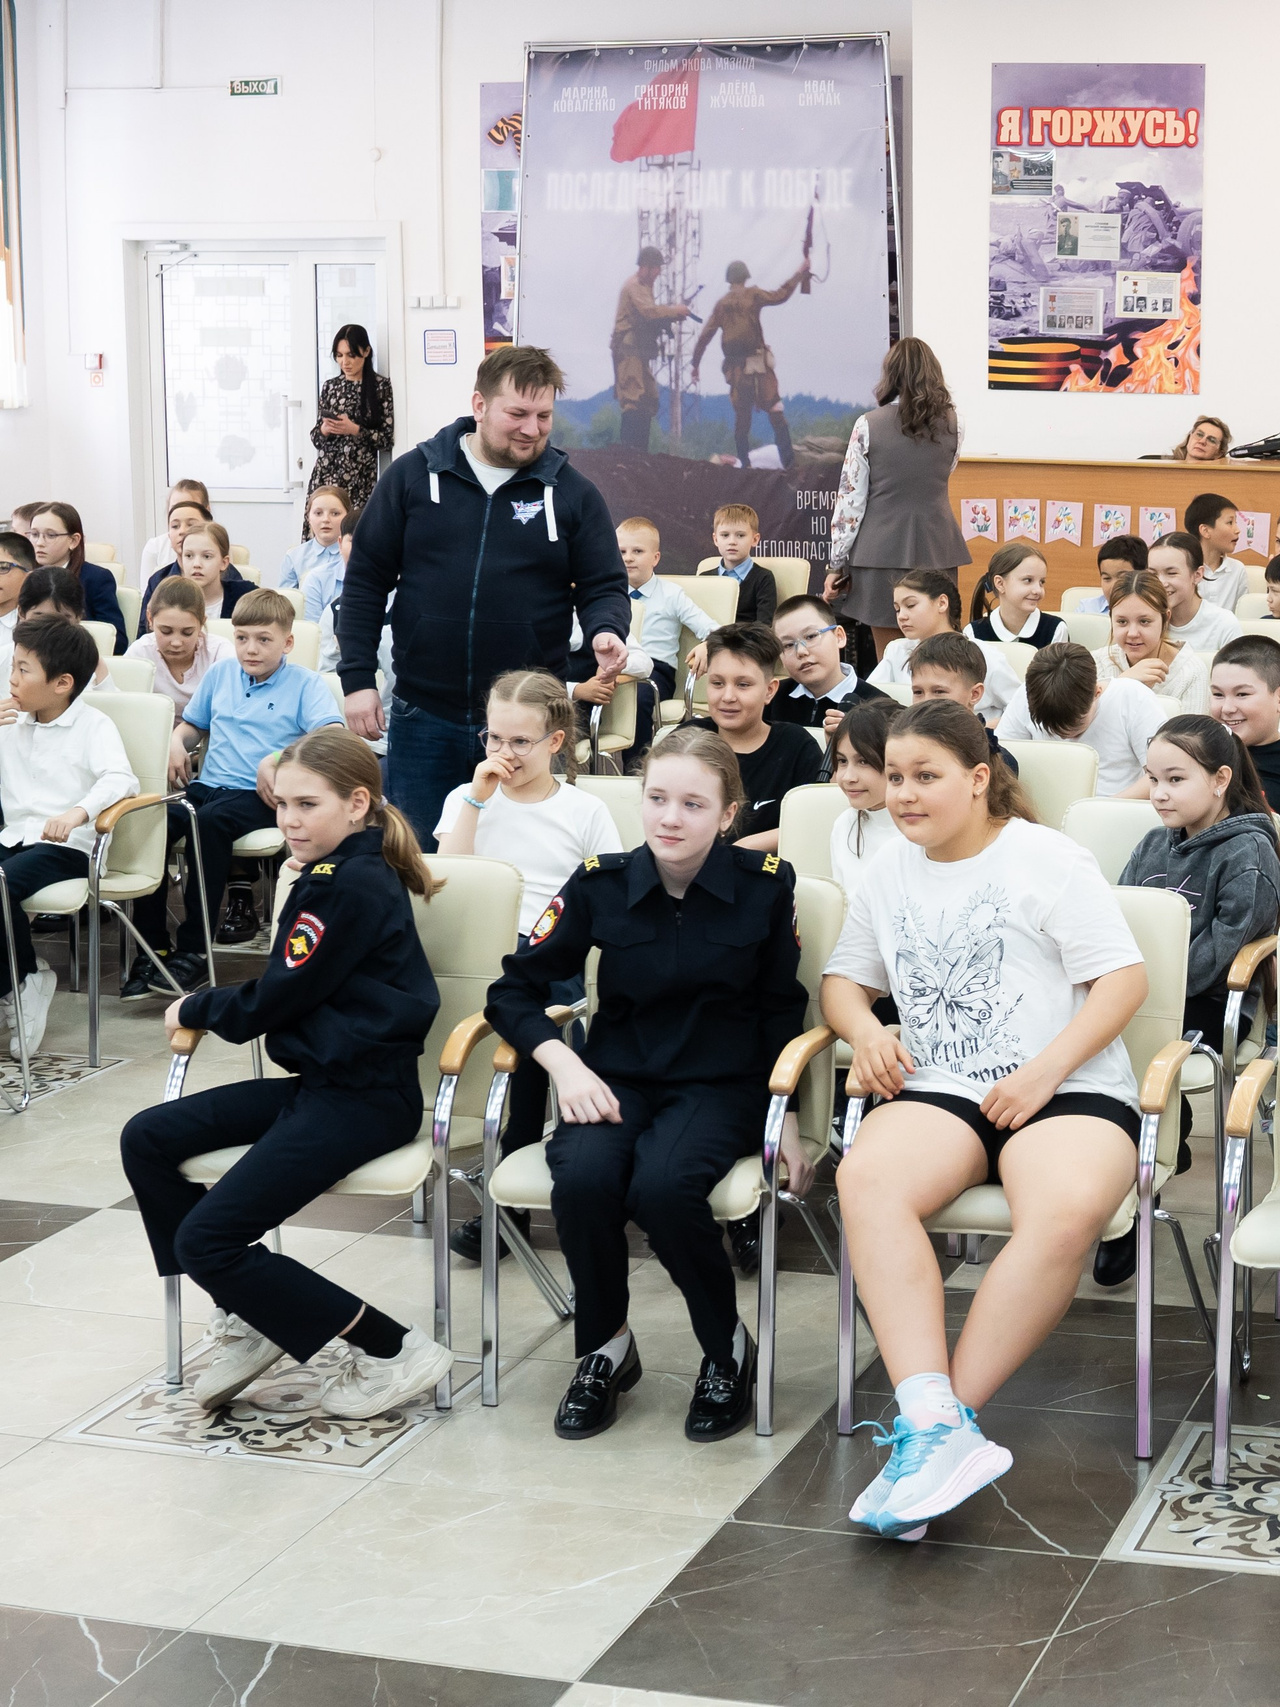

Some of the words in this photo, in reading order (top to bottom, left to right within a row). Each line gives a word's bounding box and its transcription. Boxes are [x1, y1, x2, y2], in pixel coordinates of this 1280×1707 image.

[644, 58, 679, 74] ФИЛЬМ
[681, 57, 713, 73] ЯКОВА
[715, 56, 755, 72] МЯЗИНА
[233, 80, 275, 94] ВЫХОД
[561, 86, 608, 99] МАРИНА
[634, 80, 689, 98] ГРИГОРИЙ
[719, 78, 756, 95] АЛЁНА
[804, 79, 834, 94] ИВАН
[553, 98, 616, 113] КОВАЛЕНКО
[636, 96, 687, 110] ТИТЯКОВ
[710, 94, 765, 109] ЖУЧКОВА
[798, 92, 842, 107] СИМАК
[997, 106, 1023, 146] Я
[1028, 106, 1200, 148] ГОРЖУСЬ!
[684, 168, 733, 210] ШАГ
[764, 167, 854, 211] ПОБЕДЕ
[796, 490, 838, 511] ВРЕМЯ
[811, 516, 827, 536] НО
[311, 863, 336, 875] КК
